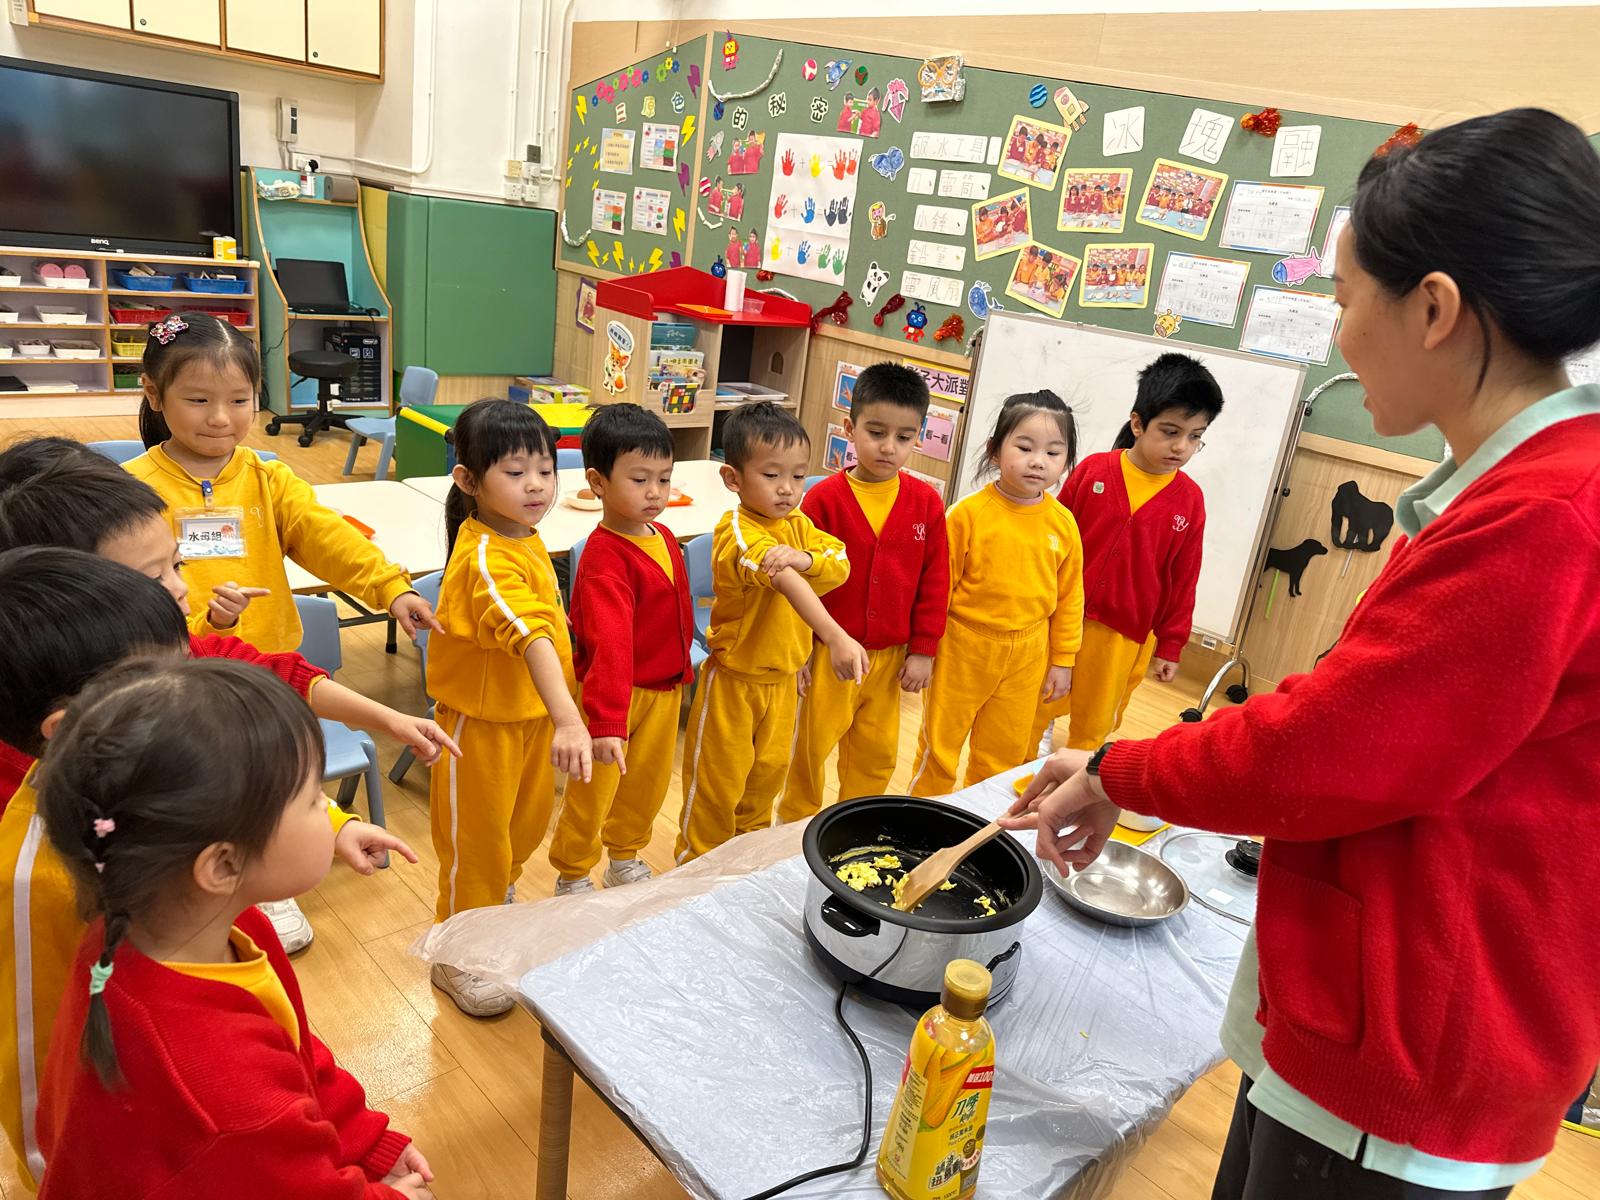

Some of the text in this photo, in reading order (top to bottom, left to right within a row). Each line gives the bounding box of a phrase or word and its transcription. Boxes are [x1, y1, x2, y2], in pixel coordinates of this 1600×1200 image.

[925, 429, 949, 445] 看一看
[188, 531, 222, 542] 水母組
